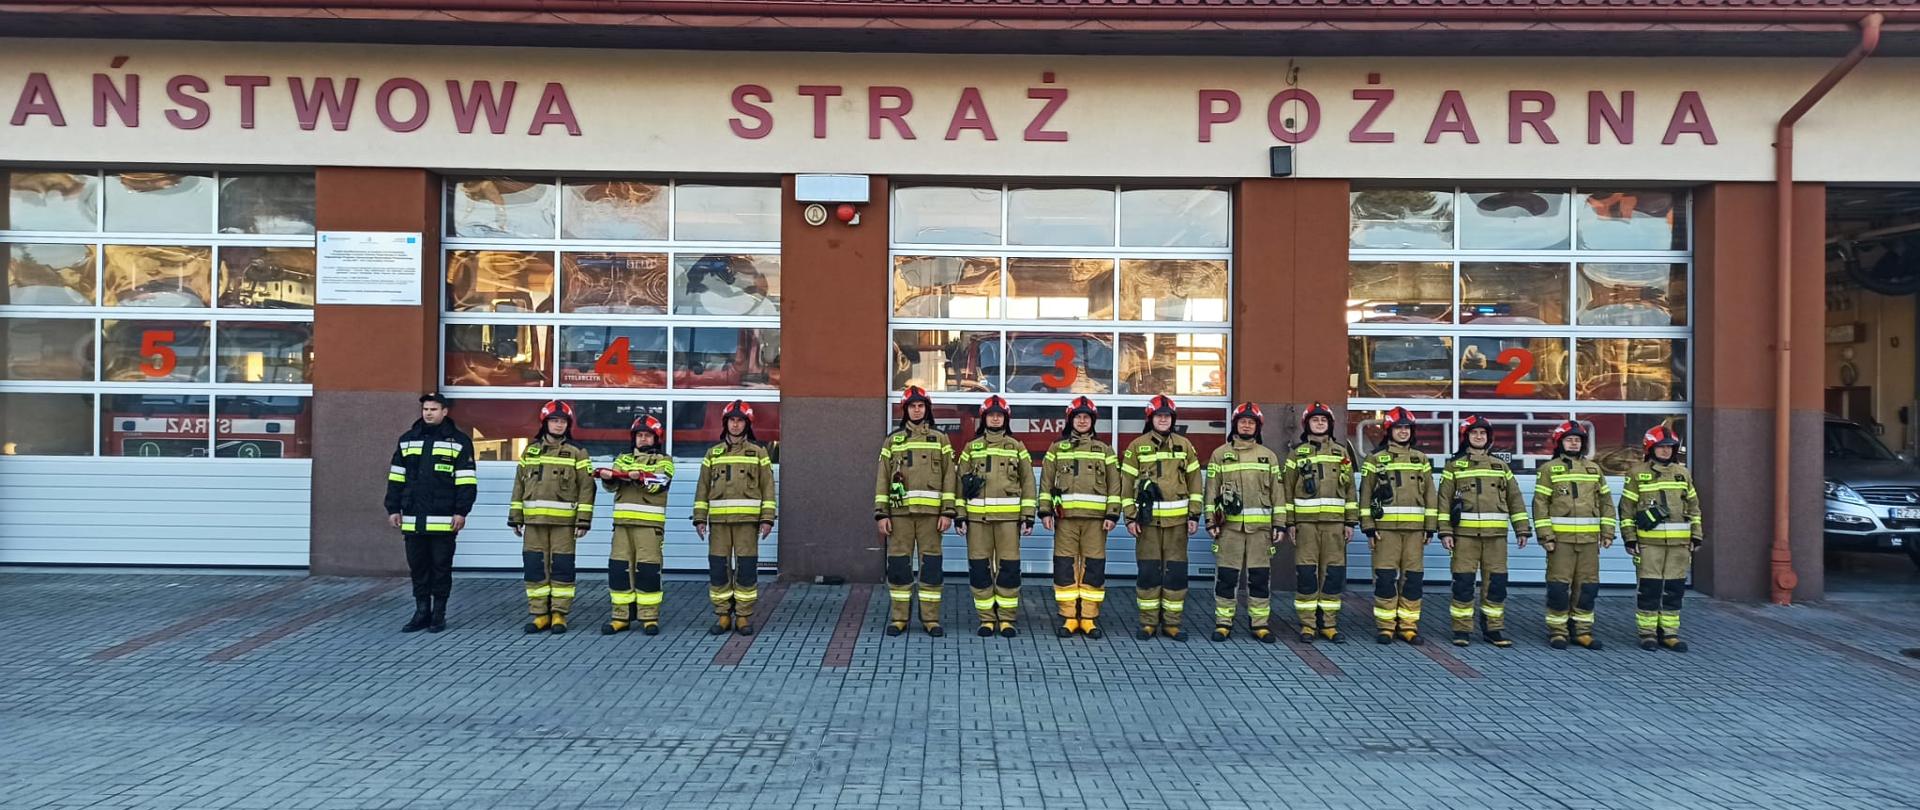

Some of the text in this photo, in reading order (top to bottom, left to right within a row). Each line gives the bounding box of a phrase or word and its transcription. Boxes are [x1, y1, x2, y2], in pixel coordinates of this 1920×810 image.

[10, 55, 1718, 145] AŃSTWOWA STRAŻ POŻARNA
[139, 330, 176, 378] 5
[594, 337, 635, 384] 4
[1040, 342, 1077, 388] 3
[1495, 348, 1535, 395] 2
